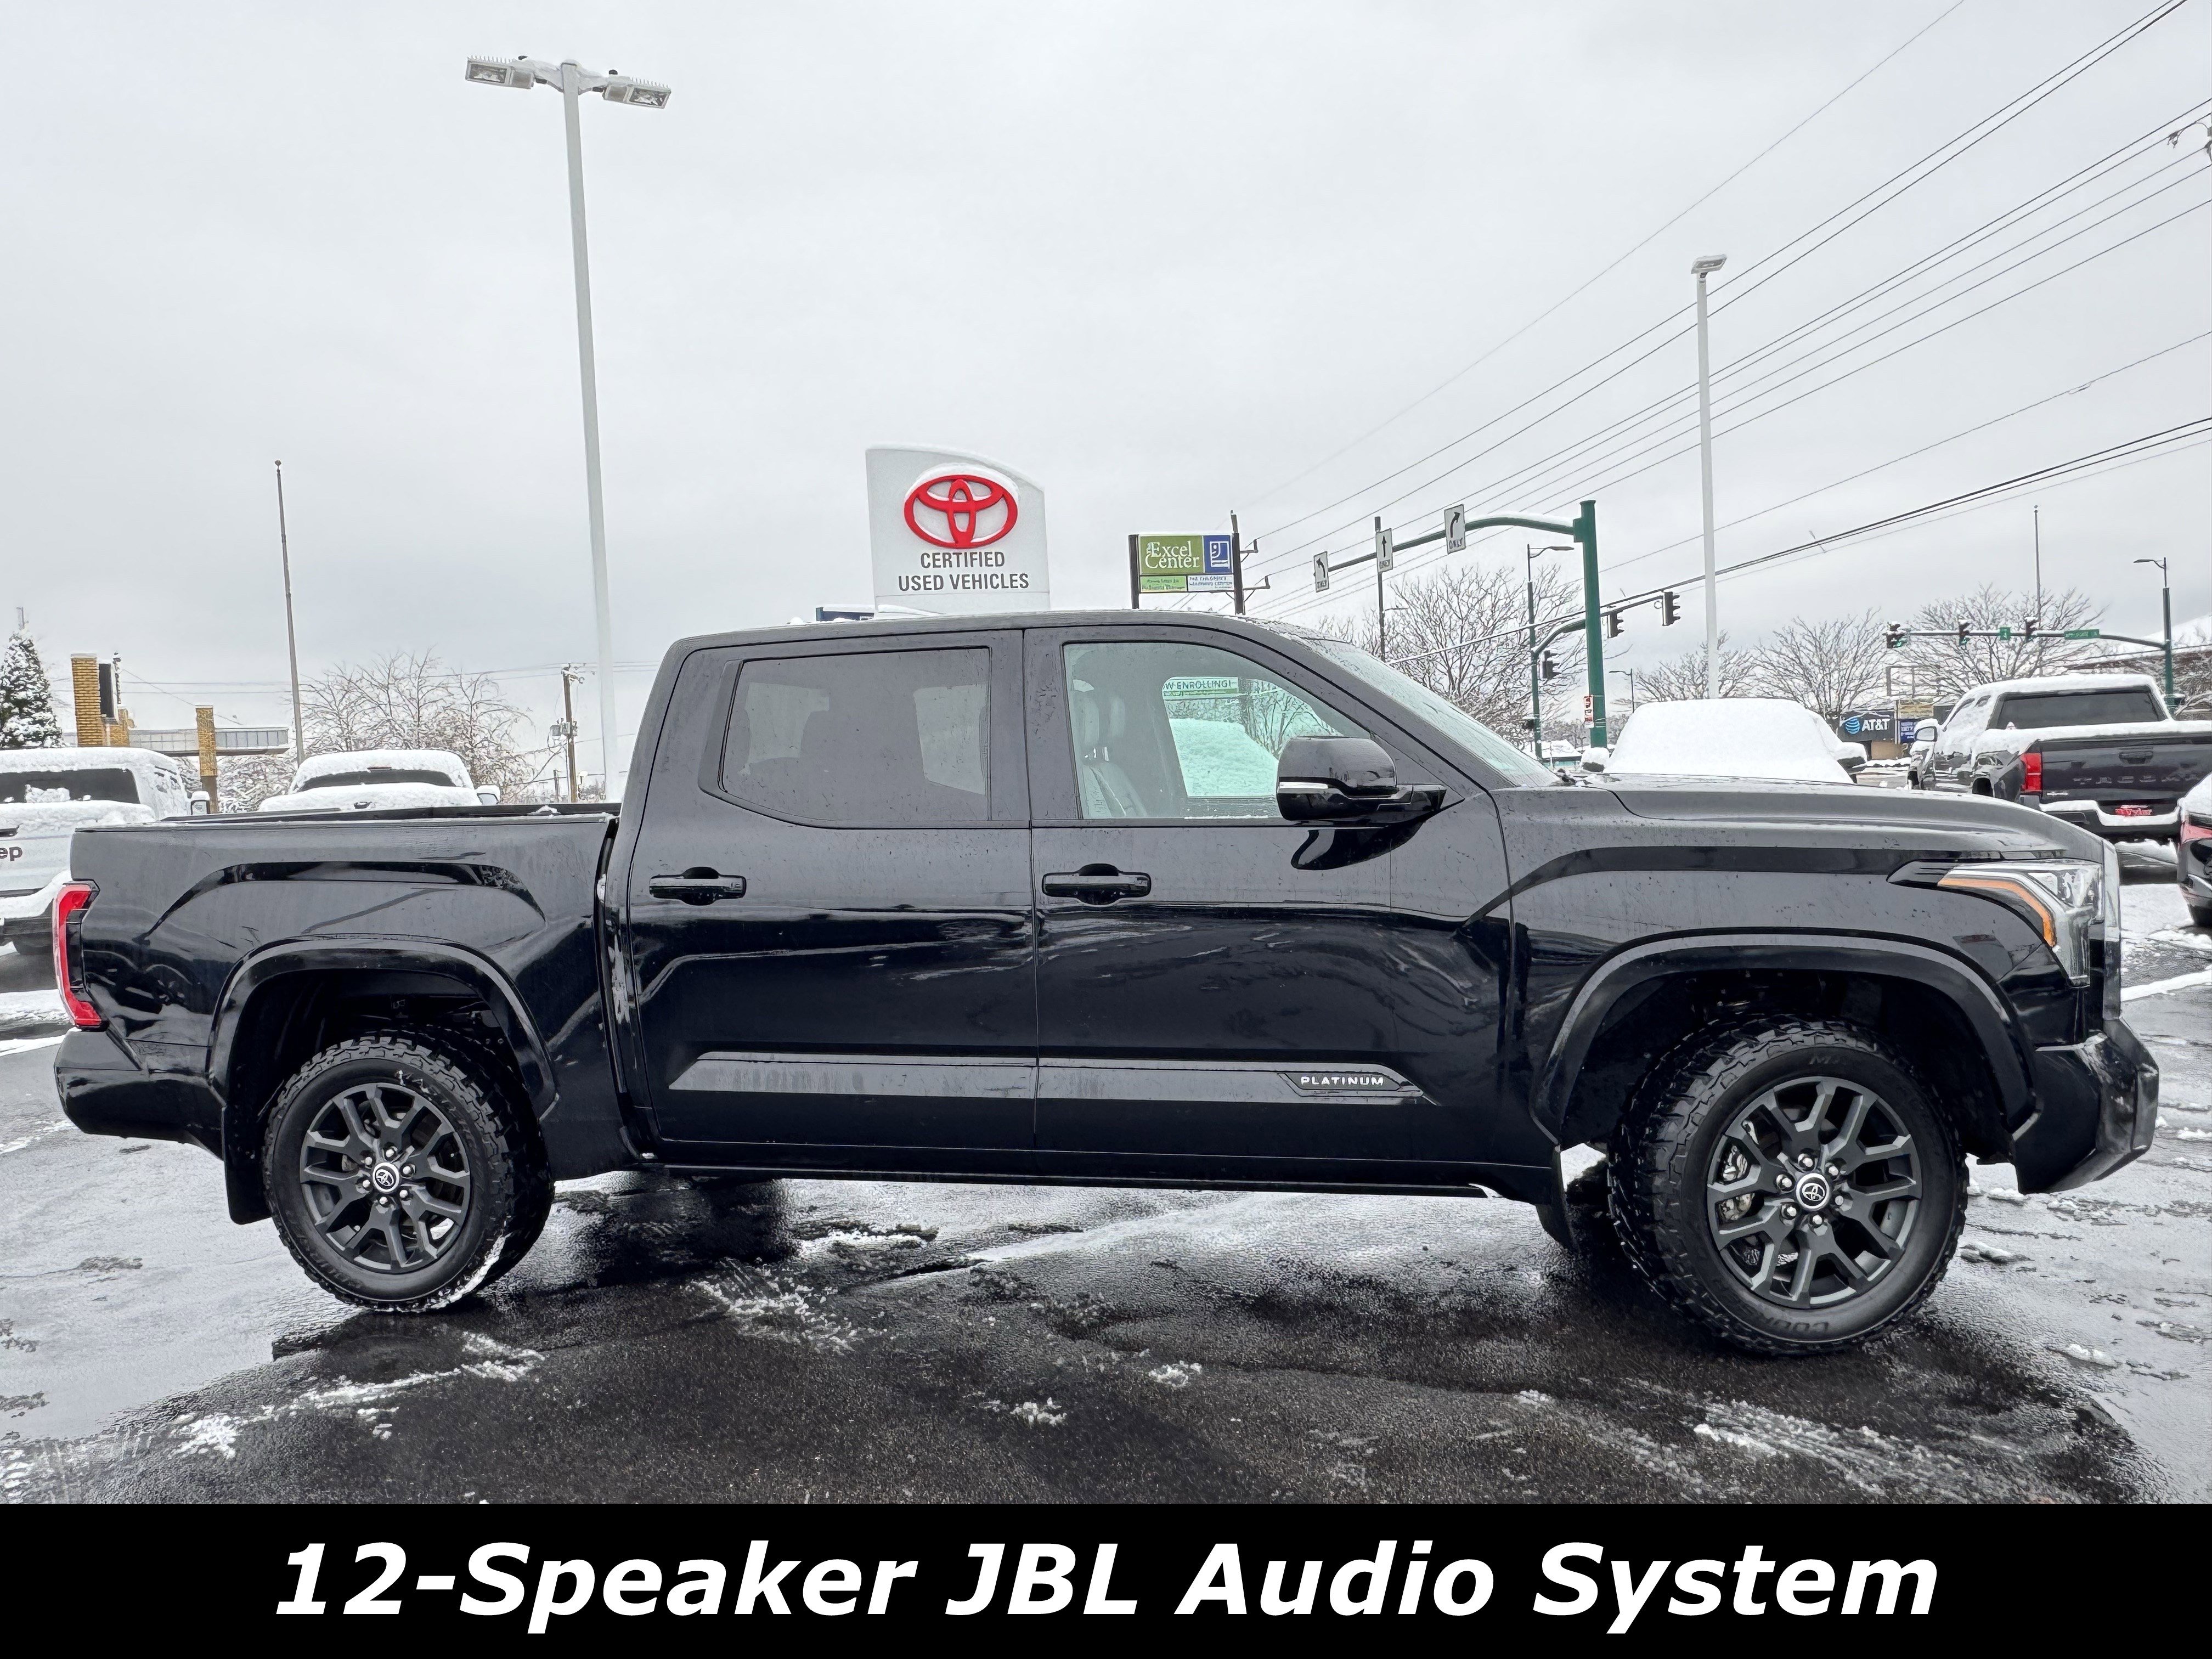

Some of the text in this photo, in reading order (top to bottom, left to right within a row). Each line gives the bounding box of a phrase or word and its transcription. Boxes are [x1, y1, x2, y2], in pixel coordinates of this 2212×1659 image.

[1150, 540, 1192, 557] Excel
[921, 551, 1005, 568] CERTIFIED
[1145, 553, 1201, 568] Center
[898, 573, 1029, 591] USED VEHICLES
[1861, 719, 1891, 732] AT&T
[1300, 1076, 1384, 1086] PLATINUM
